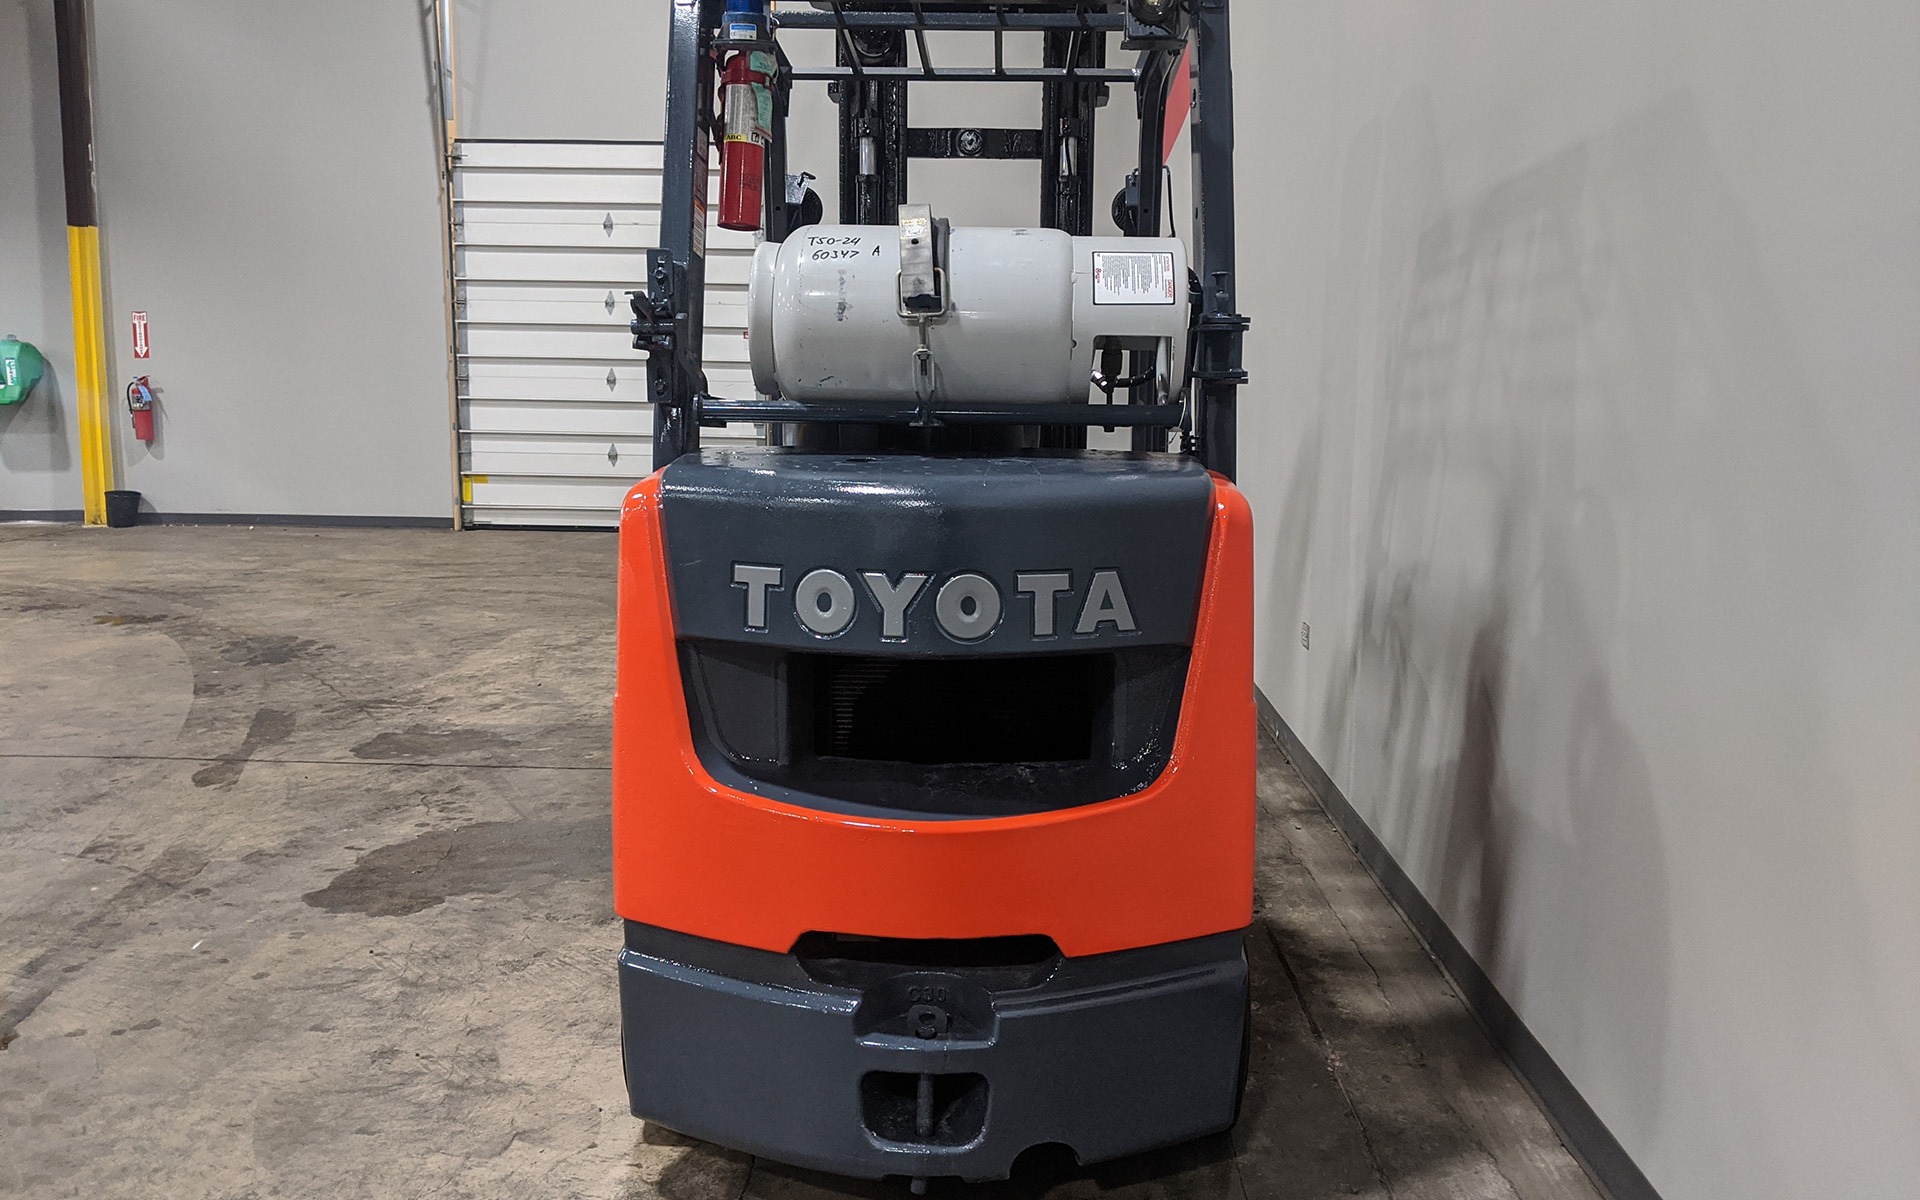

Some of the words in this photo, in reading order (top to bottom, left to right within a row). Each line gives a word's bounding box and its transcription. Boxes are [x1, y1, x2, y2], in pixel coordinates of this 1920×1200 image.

[812, 249, 860, 261] 60347
[871, 245, 881, 257] A
[133, 314, 146, 322] FIRE
[731, 561, 1140, 642] TOYOTA
